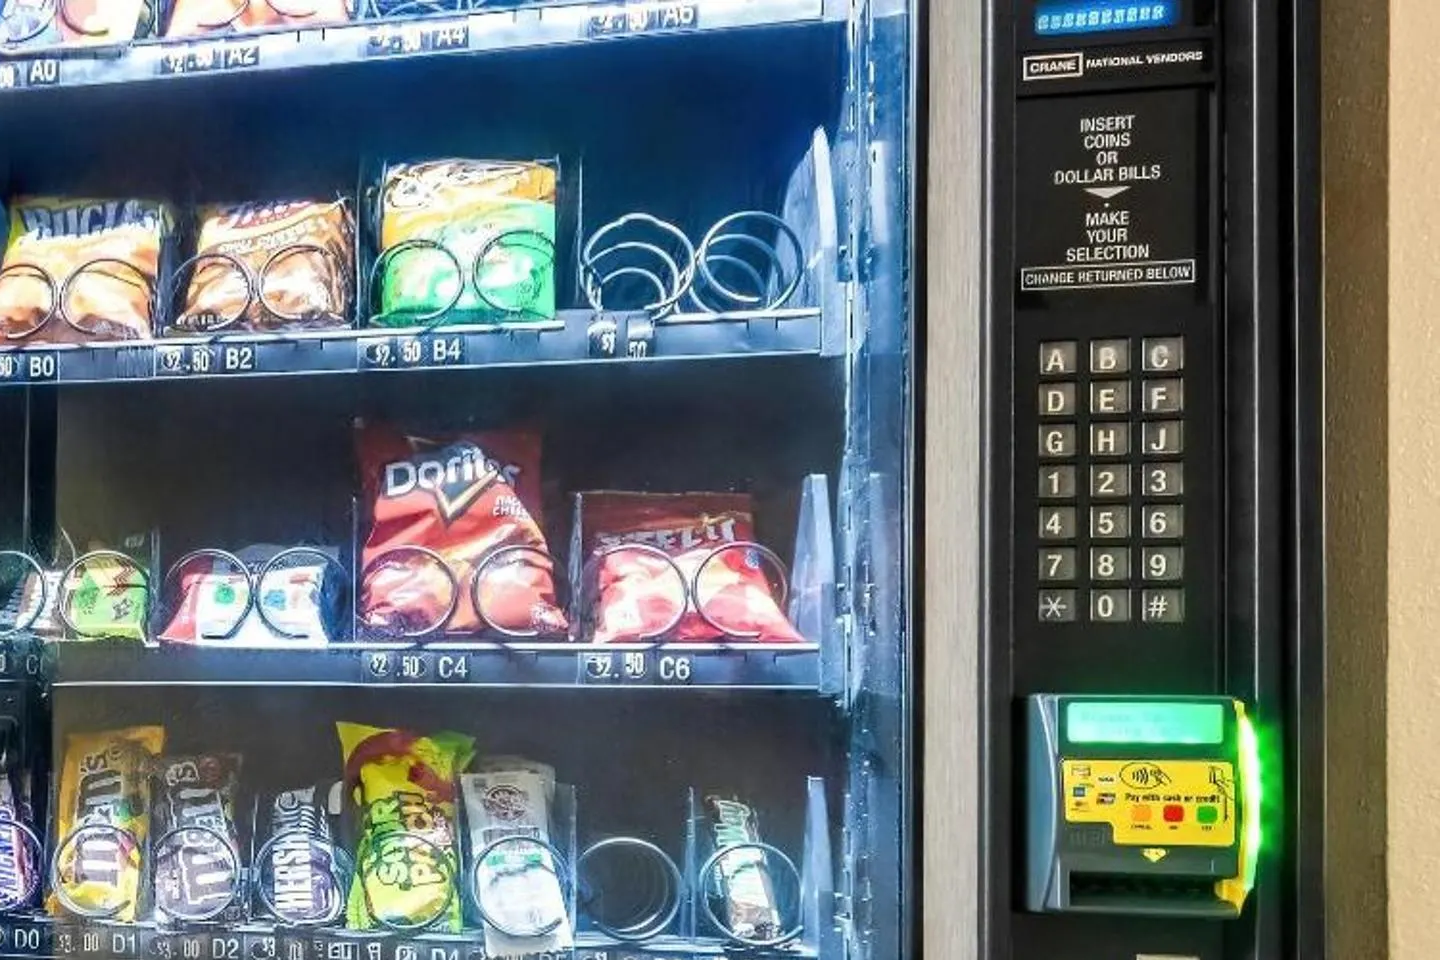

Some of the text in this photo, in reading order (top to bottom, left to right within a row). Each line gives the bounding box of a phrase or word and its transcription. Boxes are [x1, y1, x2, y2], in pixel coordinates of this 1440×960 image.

[1029, 61, 1077, 74] CRANE
[1086, 51, 1203, 68] NATIONAL VENDORS
[1080, 115, 1136, 133] INSERT
[1084, 132, 1131, 149] COINS
[1096, 151, 1118, 166] OR
[1054, 165, 1161, 185] DOLLAR BILLS
[1085, 211, 1130, 227] MAKE
[1086, 228, 1128, 244] YOUR
[1066, 244, 1149, 262] SELECTION
[1025, 265, 1191, 286] CHANGE RETURNED BELOW
[226, 347, 253, 369] B2
[433, 338, 462, 361] B4
[1046, 345, 1168, 372] A B C
[1047, 387, 1167, 412] D E F
[1046, 428, 1166, 453] G H J
[385, 447, 521, 498] Doritos
[1047, 469, 1167, 494] 1 2 3
[1046, 511, 1167, 535] 4 5 6
[1047, 554, 1167, 577] 7 8 9
[1098, 595, 1114, 618] 0
[1148, 595, 1168, 618] #
[438, 656, 468, 679] C4
[659, 656, 691, 680] C6
[14, 928, 40, 949] D0
[112, 933, 136, 953] D1
[212, 938, 240, 960] D2
